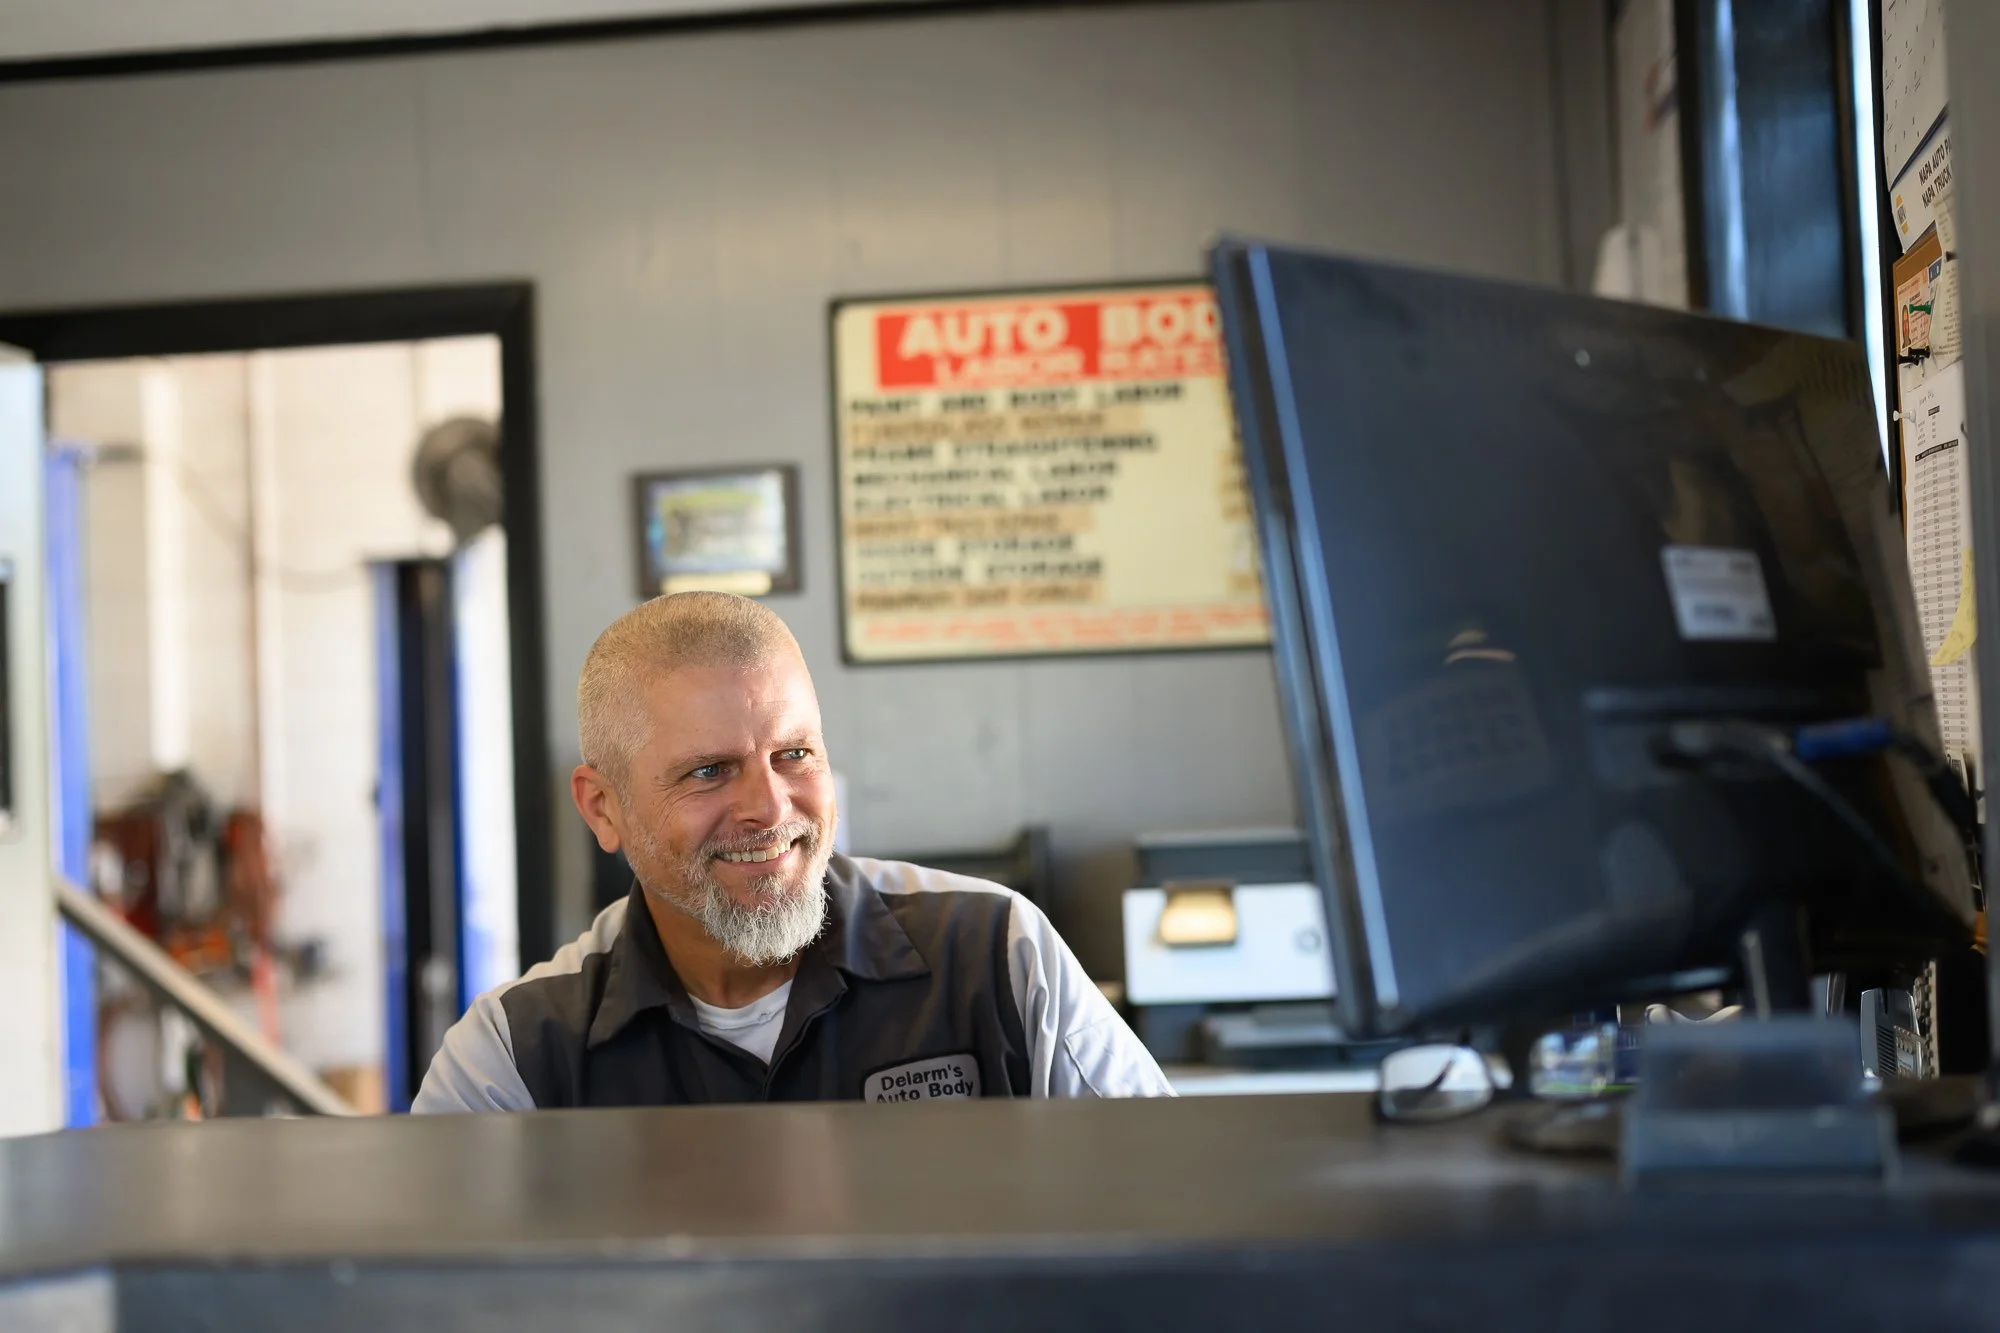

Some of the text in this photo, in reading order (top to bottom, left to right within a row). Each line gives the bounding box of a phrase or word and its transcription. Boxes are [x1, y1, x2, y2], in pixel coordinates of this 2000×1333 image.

[1918, 160, 1933, 187] NAPA
[1932, 144, 1945, 171] AUTO
[1921, 185, 1936, 208] NAPA
[898, 306, 1068, 359] AUTO
[937, 391, 991, 412] AND
[1006, 387, 1078, 409] BODY
[1094, 382, 1186, 404] LABOR
[881, 1064, 964, 1091] Delarm's
[877, 1080, 974, 1104] Auto Body
